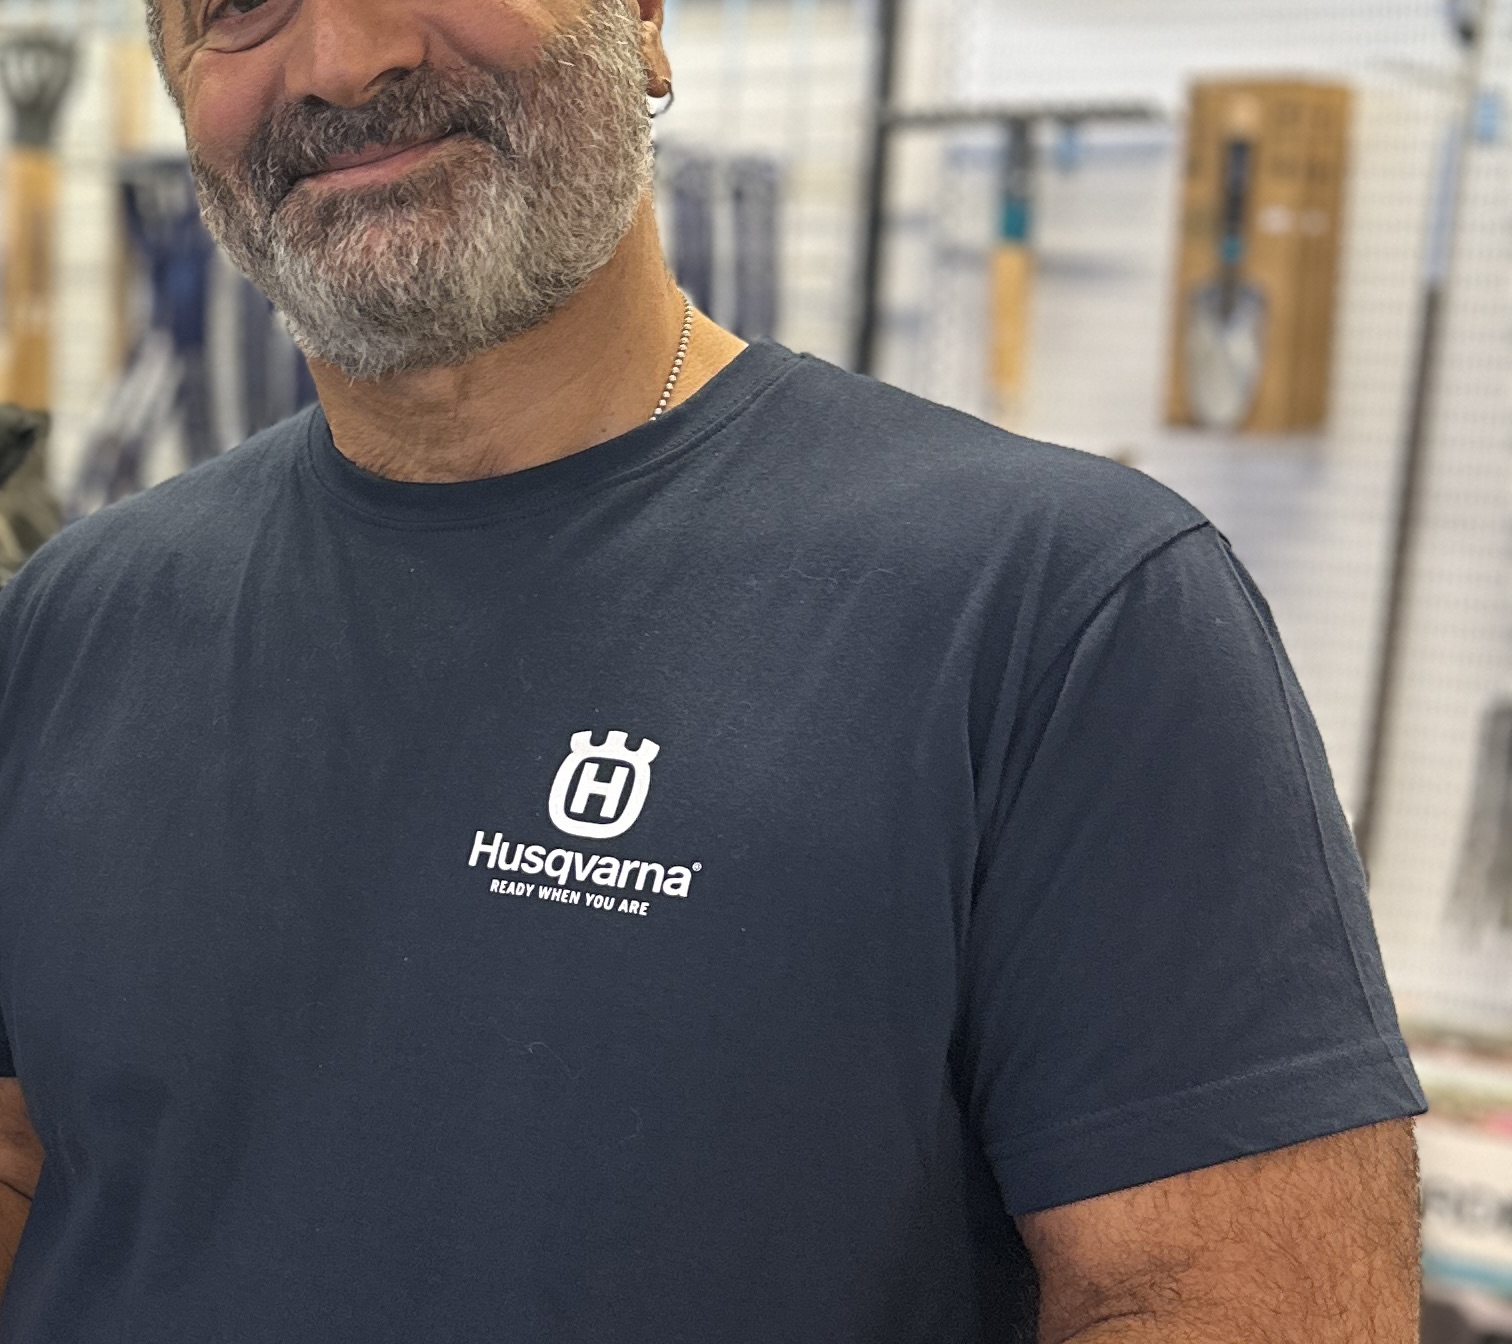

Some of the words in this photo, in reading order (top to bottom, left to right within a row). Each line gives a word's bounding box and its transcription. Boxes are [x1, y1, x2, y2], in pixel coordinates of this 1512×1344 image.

[570, 761, 630, 819] H
[489, 878, 535, 898] READY
[538, 886, 581, 905] WHEN
[585, 893, 615, 911] YOU
[618, 899, 650, 917] ARE
